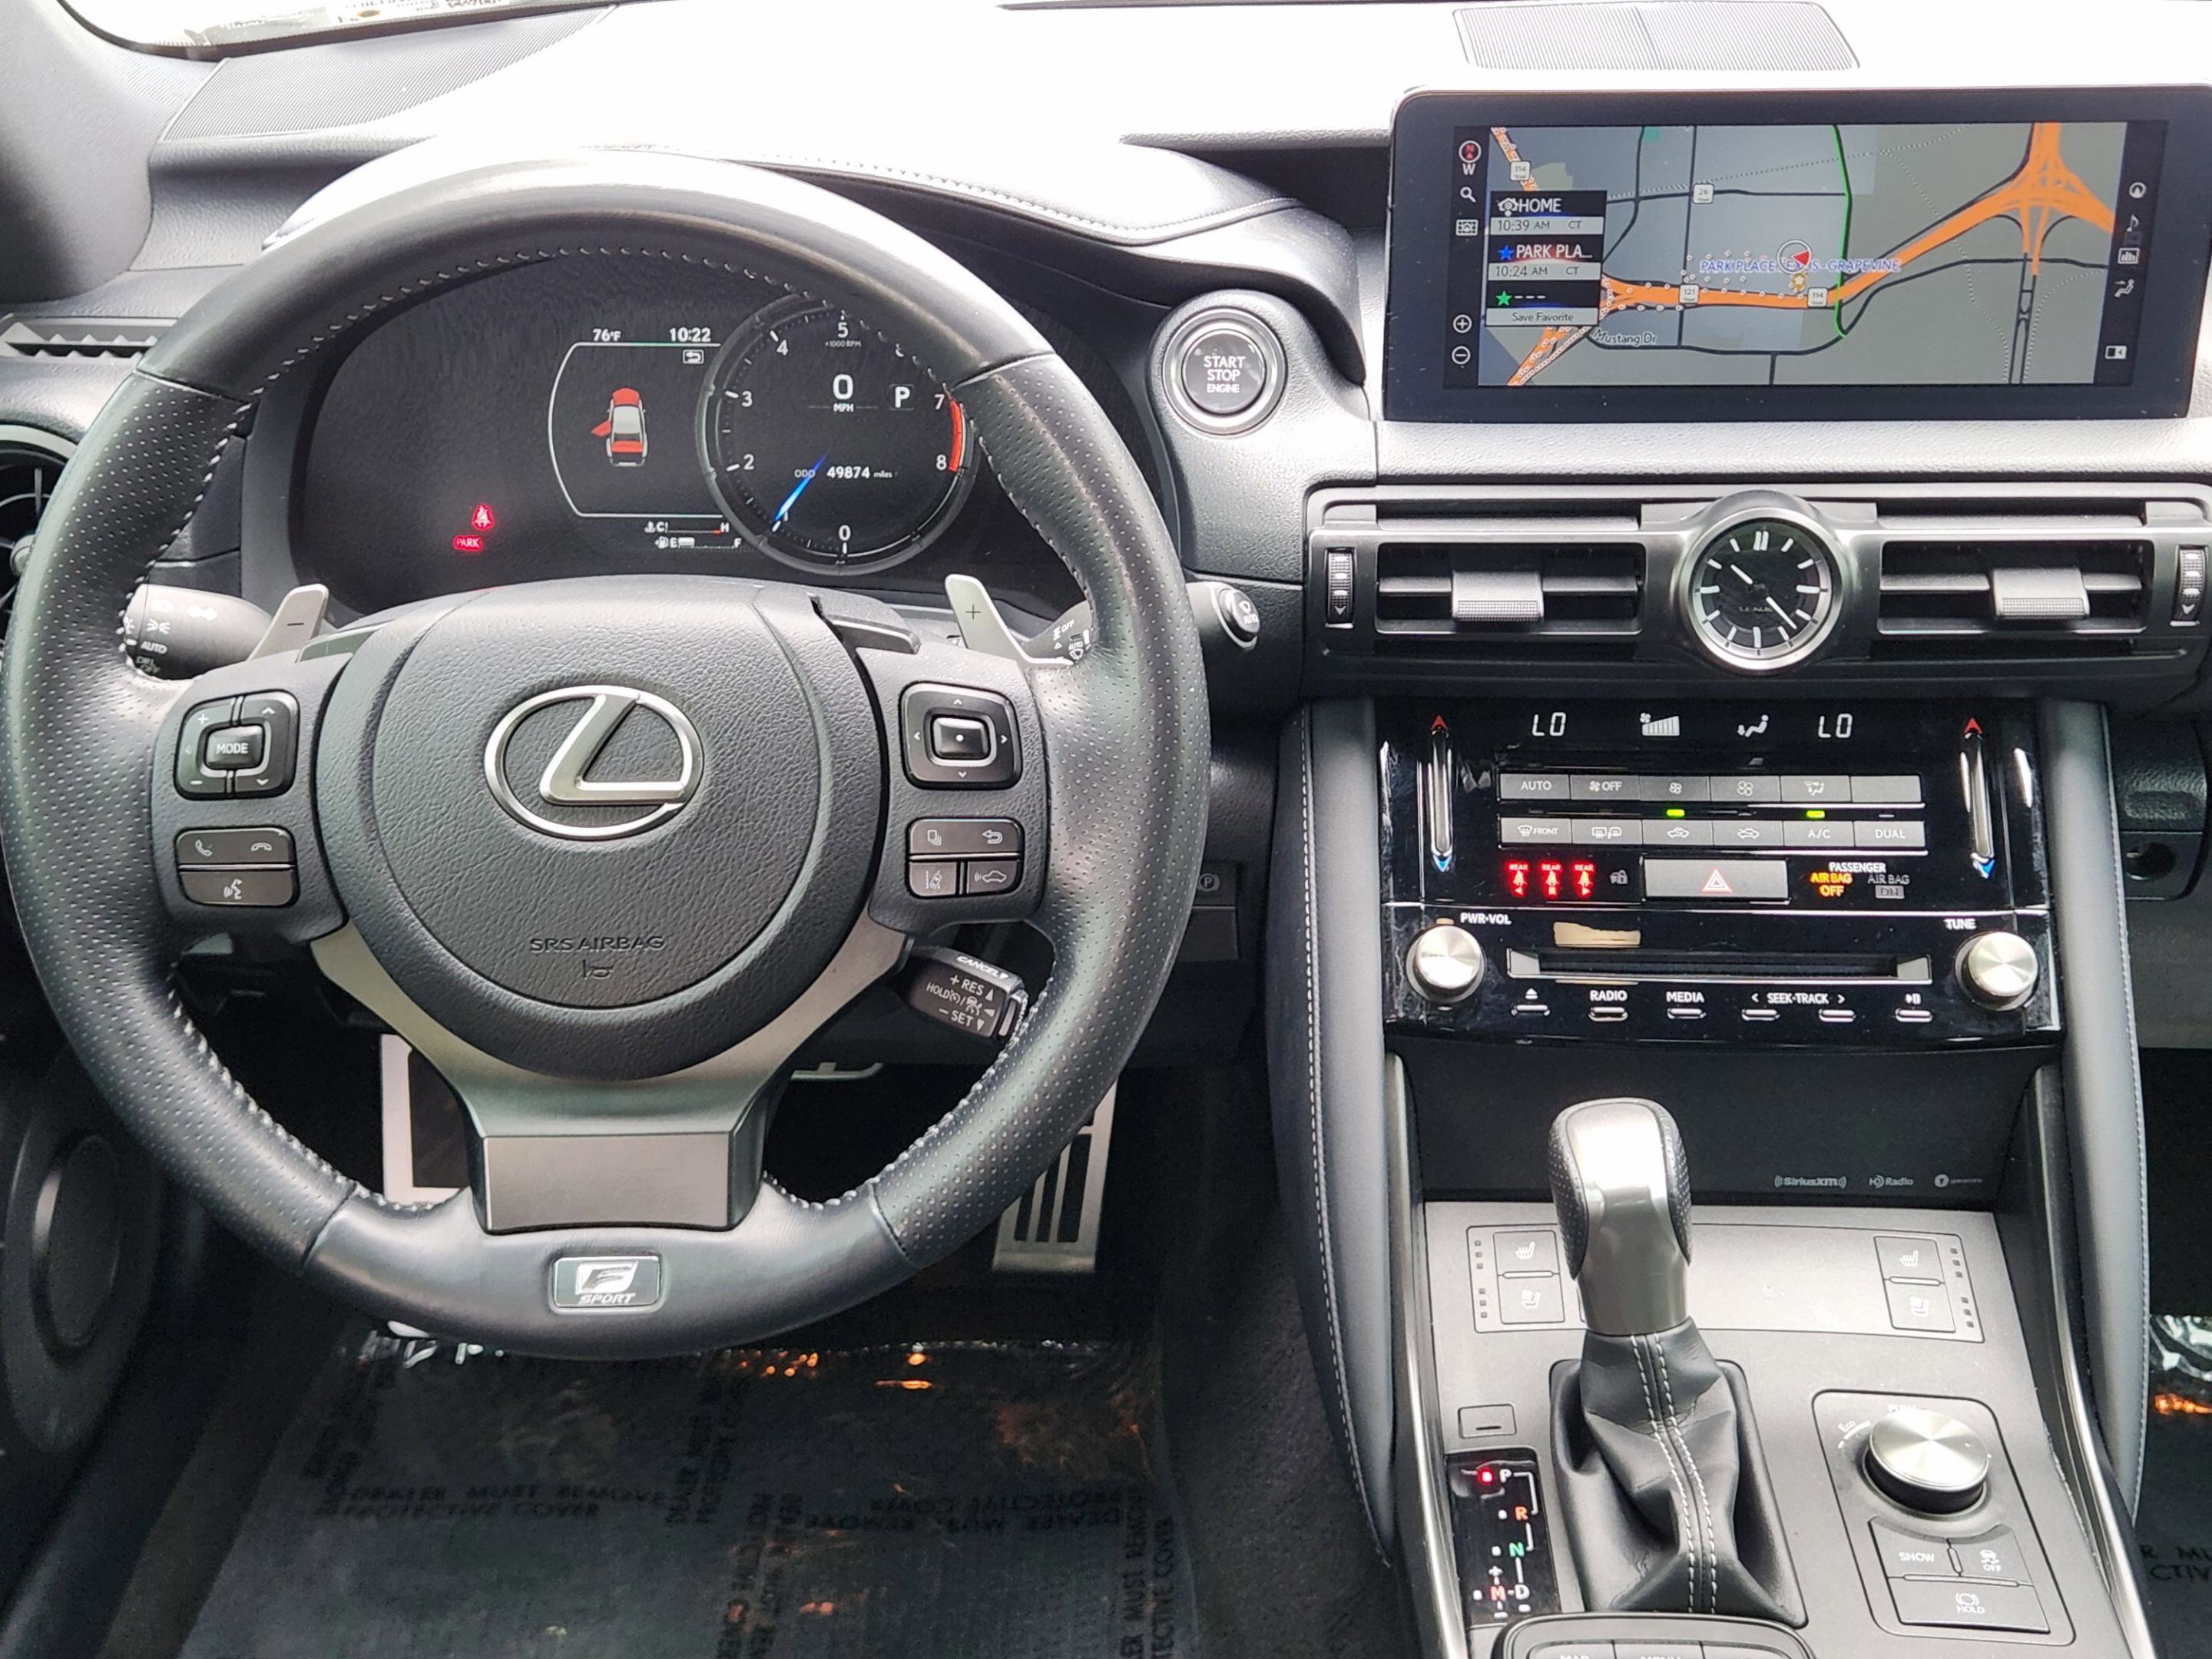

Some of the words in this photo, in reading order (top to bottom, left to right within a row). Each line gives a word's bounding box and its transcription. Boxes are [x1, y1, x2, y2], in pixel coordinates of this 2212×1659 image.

[1462, 163, 1476, 175] W
[1518, 198, 1562, 213] HOME
[1498, 220, 1530, 232] 10:39
[1534, 220, 1550, 230] AM
[1568, 220, 1582, 230] CT
[1516, 244, 1552, 259] PARK
[1495, 266, 1528, 277] 10:24
[1531, 267, 1548, 276] AM
[1565, 266, 1579, 275] CT
[1700, 260, 1734, 272] PARK
[1736, 260, 1776, 271] PLACE
[1827, 259, 1899, 272] GRAPEVINE
[1512, 312, 1533, 322] Save
[1536, 312, 1573, 322] Favorite
[670, 327, 710, 342] 10:22
[836, 322, 849, 339] 5
[1593, 329, 1641, 345] Mustang
[1643, 332, 1657, 344] Dr
[776, 339, 789, 356] 4
[1204, 356, 1245, 369] START
[1207, 369, 1240, 382] STOP
[1207, 384, 1240, 393] ENGINE
[741, 392, 753, 407] 3
[894, 386, 910, 408] P
[933, 394, 945, 410] 7
[833, 402, 854, 412] MPH
[743, 454, 755, 470] 2
[936, 455, 948, 470] 8
[794, 469, 816, 478] ODO
[826, 466, 870, 479] 49874
[873, 469, 892, 478] miles
[720, 523, 730, 532] H
[839, 525, 851, 541] 0
[456, 538, 480, 548] PARK
[733, 538, 742, 548] F
[141, 641, 167, 654] AUTO
[1532, 712, 1566, 736] LO
[1817, 714, 1853, 738] LO
[216, 743, 248, 754] MODE
[1521, 780, 1551, 791] AUTO
[1601, 781, 1622, 791] OFF
[1533, 826, 1558, 836] FRONT
[1808, 828, 1830, 839] A/C
[1875, 829, 1906, 839] DUAL
[1829, 862, 1886, 873] PASSENGER
[1204, 877, 1213, 887] P
[1867, 874, 1886, 884] AIR
[1888, 875, 1910, 885] BAG
[1820, 885, 1844, 897] OFF
[1945, 919, 1976, 929] TUNE
[531, 937, 573, 952] SRS
[578, 935, 665, 952] AIRBAG
[956, 955, 998, 978] CANCEL
[926, 982, 950, 999] HOLD
[1590, 990, 1628, 1002] RADIO
[1666, 992, 1704, 1004] MEDIA
[1886, 1177, 1913, 1186] Radio
[578, 1293, 636, 1305] SPORT
[1500, 1469, 1512, 1482] P
[1515, 1506, 1528, 1520] R
[1509, 1543, 1524, 1557] N
[1899, 1551, 1935, 1562] SNOW
[1982, 1564, 2002, 1572] OFF
[1491, 1586, 1507, 1601] M
[1515, 1584, 1530, 1600] D
[1956, 1604, 1985, 1614] HOLD
